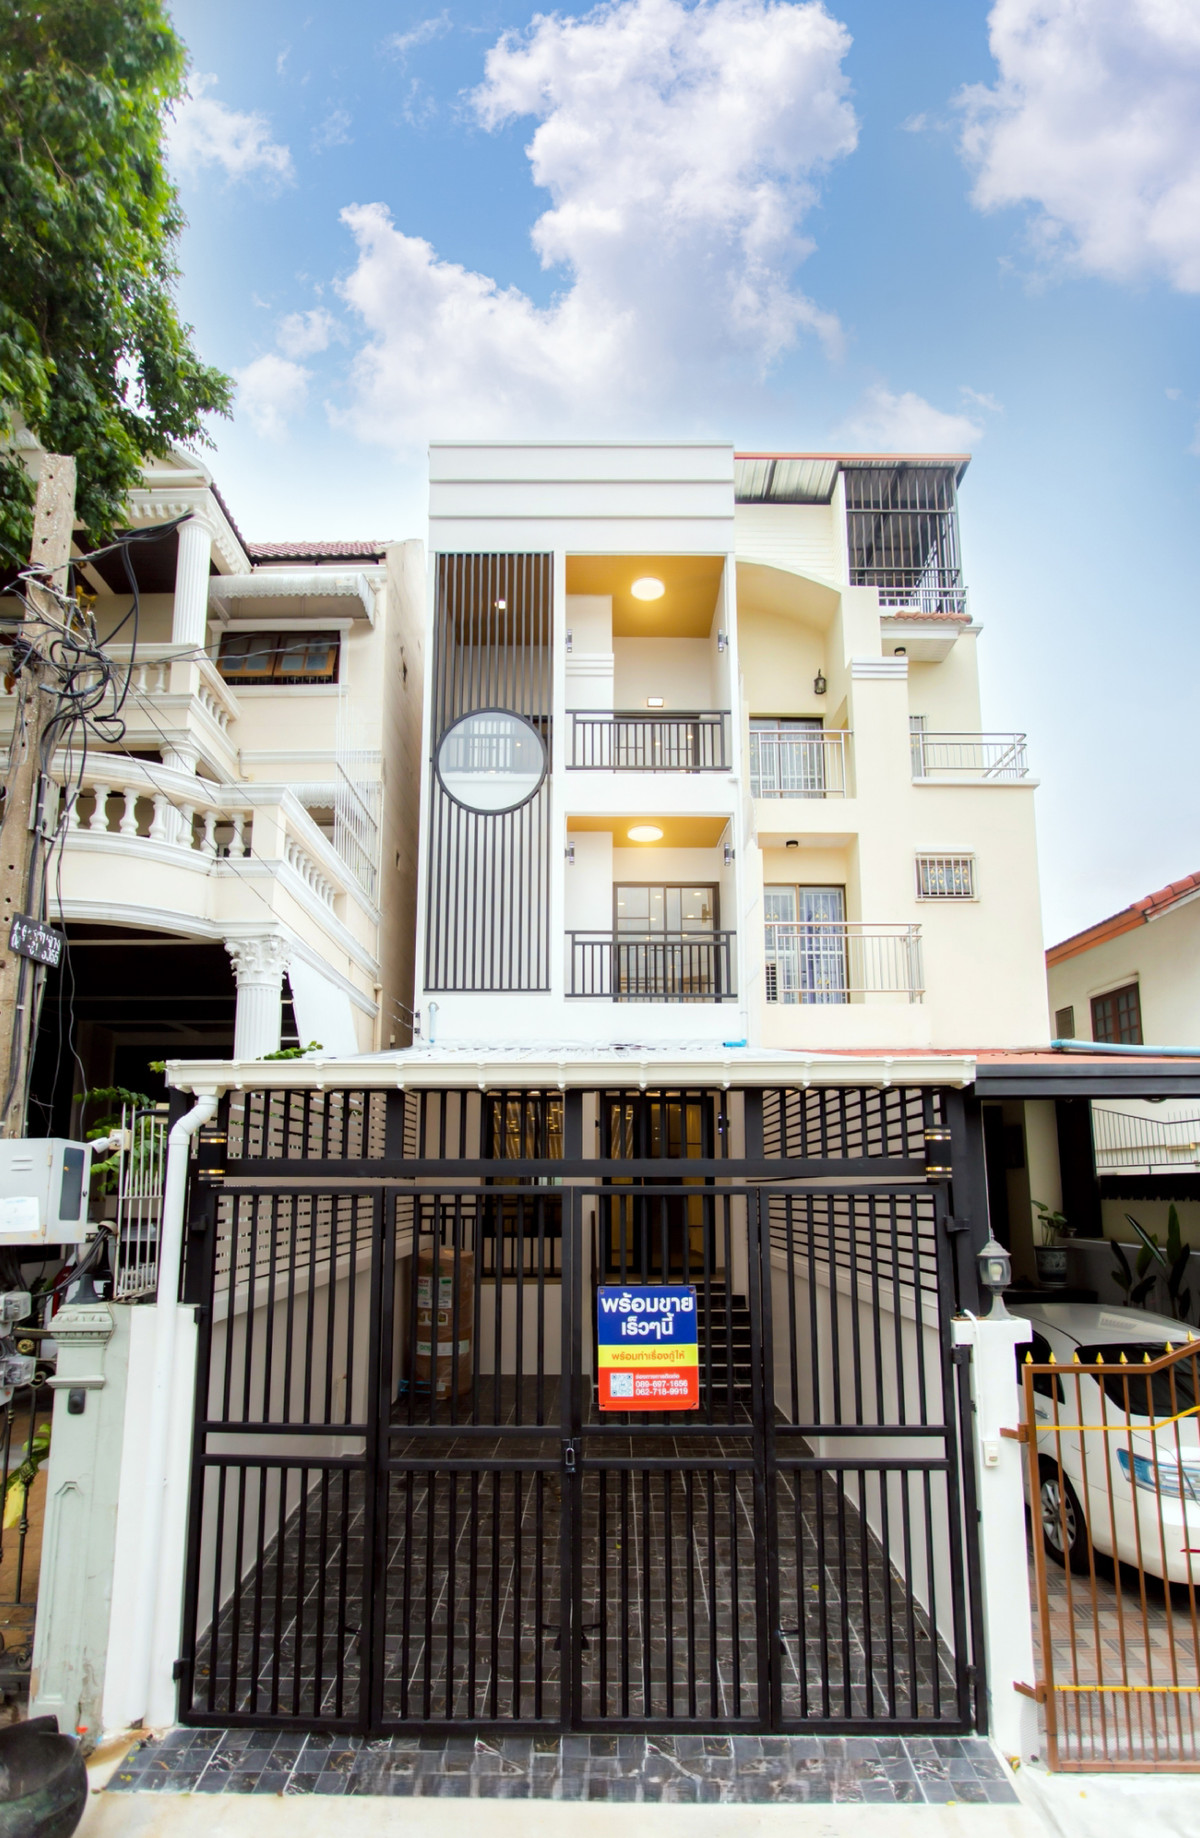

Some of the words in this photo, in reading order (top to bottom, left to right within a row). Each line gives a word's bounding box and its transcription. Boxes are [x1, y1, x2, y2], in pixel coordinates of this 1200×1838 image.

[601, 1292, 694, 1313] พร้อมขาย
[621, 1312, 675, 1340] เร็วๆนี้
